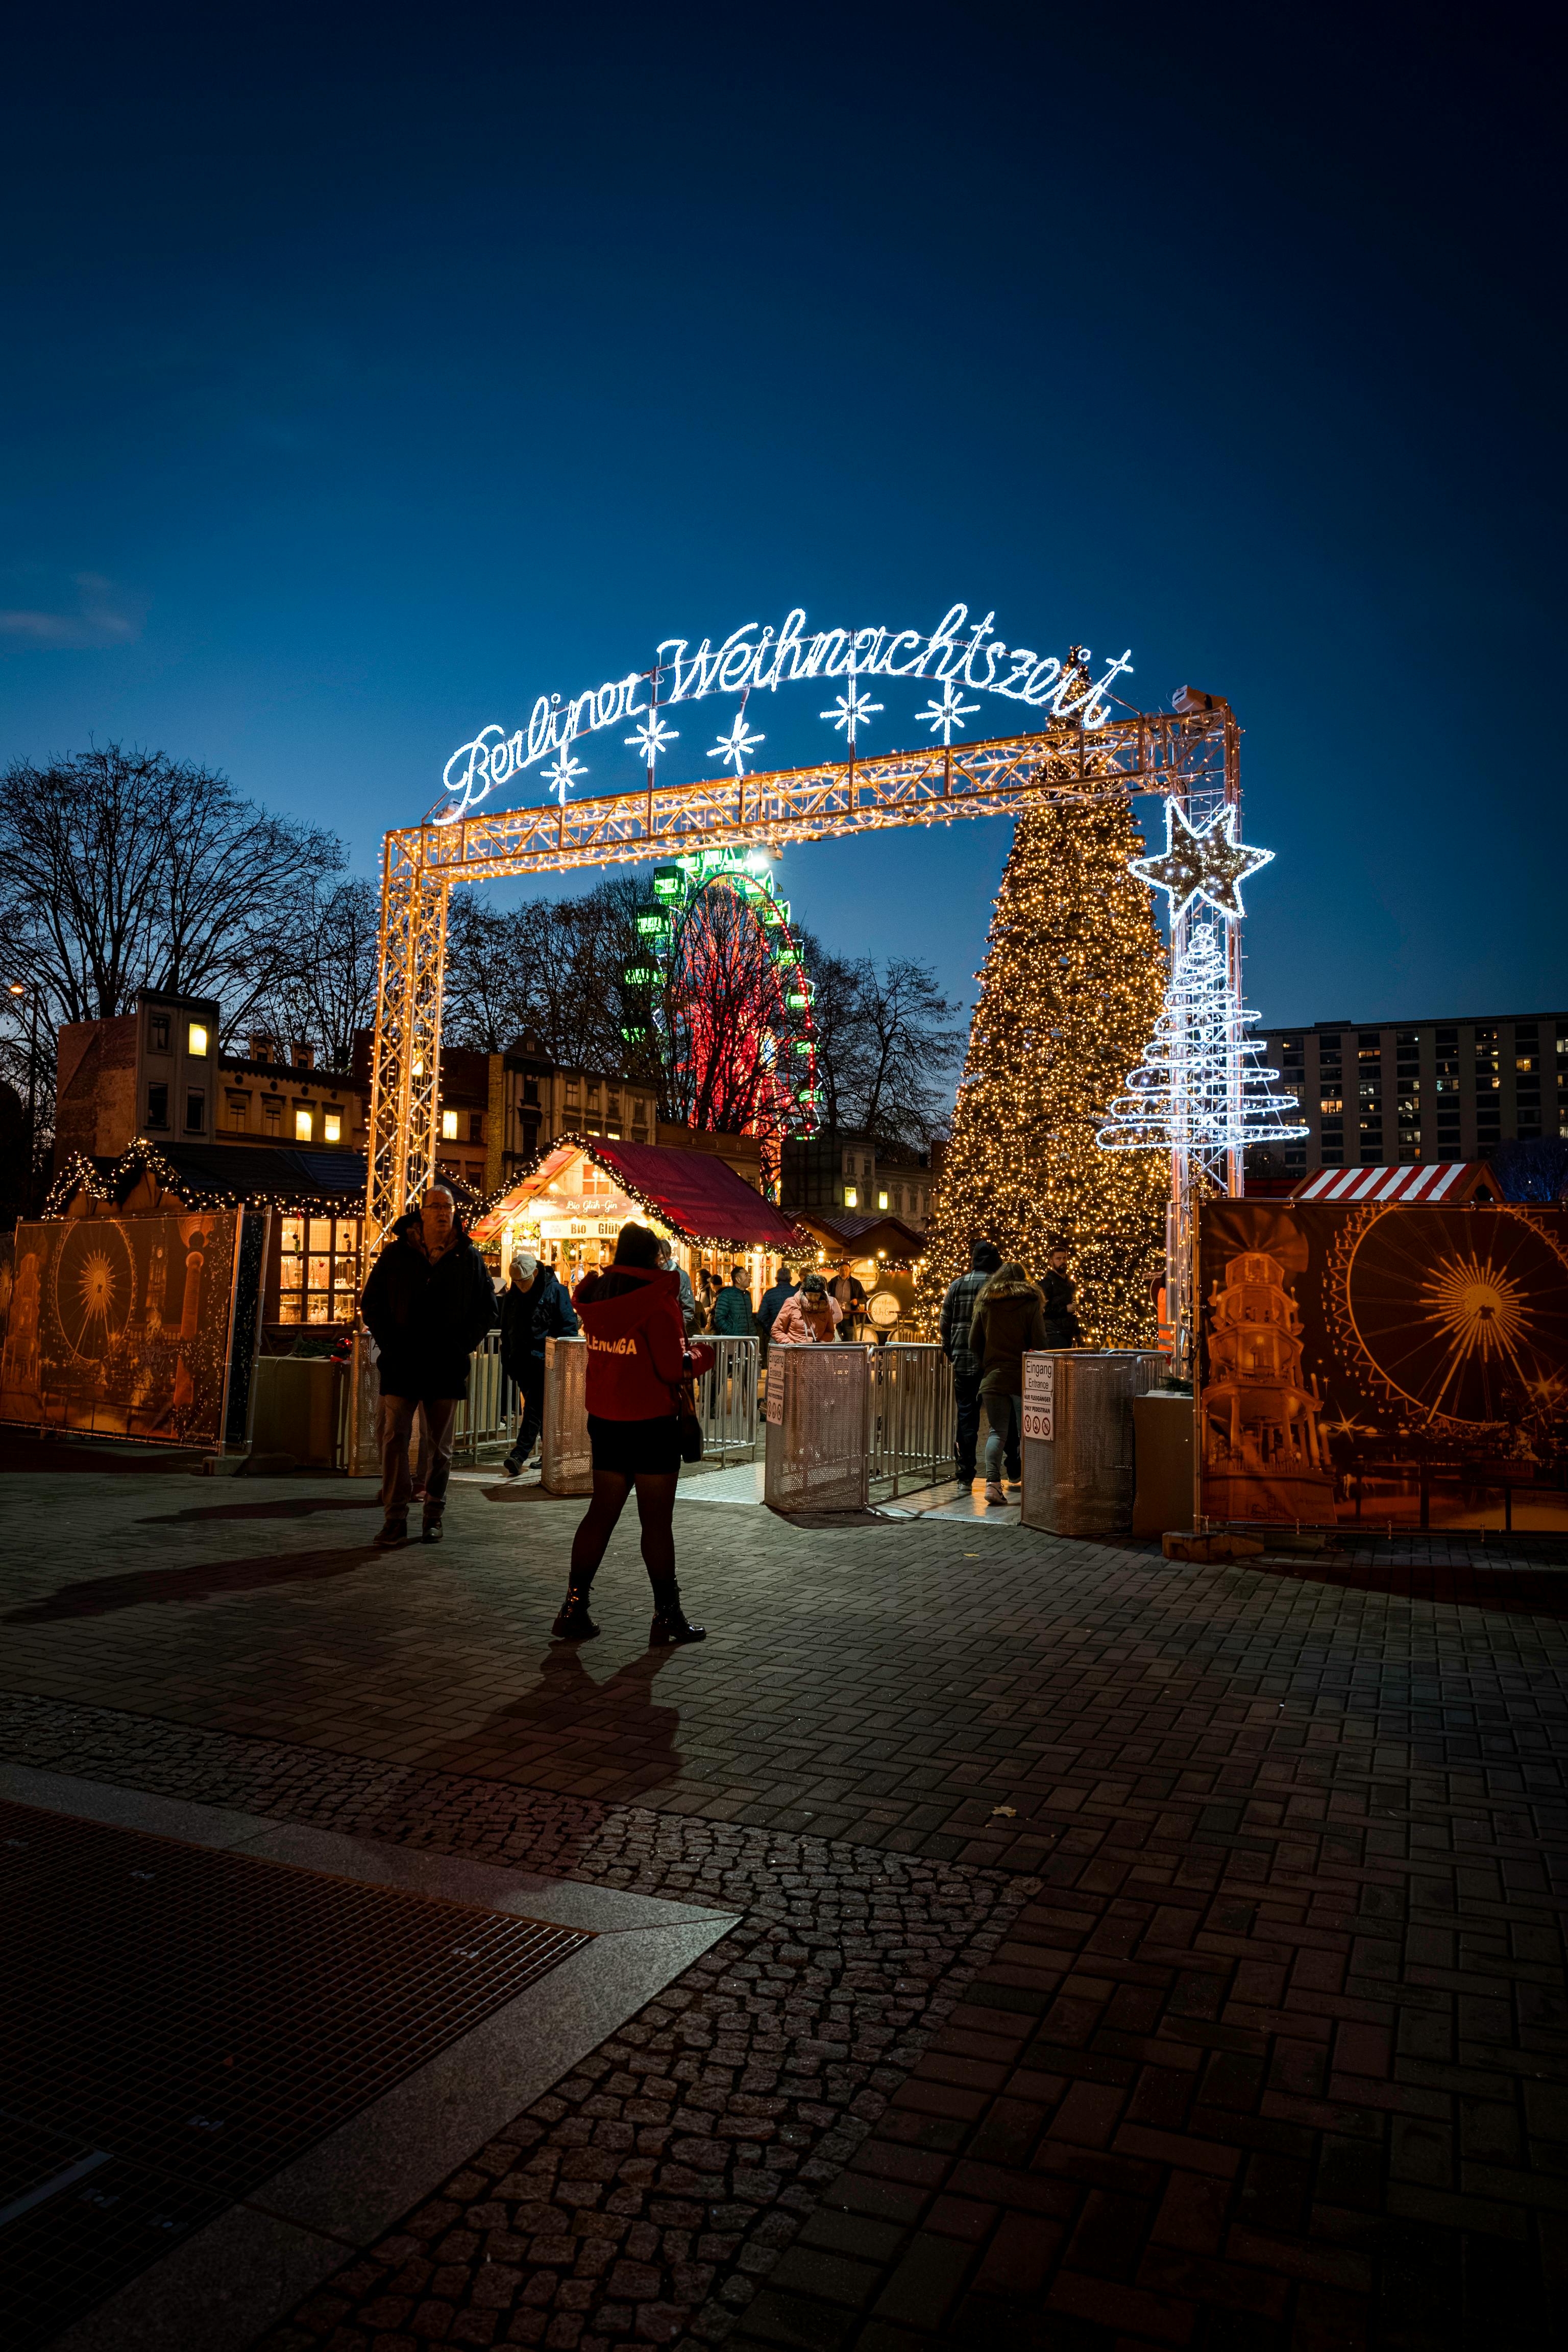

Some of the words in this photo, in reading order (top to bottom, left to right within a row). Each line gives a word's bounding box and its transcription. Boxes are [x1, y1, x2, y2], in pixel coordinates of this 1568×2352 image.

[432, 673, 647, 826] Berliner
[656, 602, 1133, 730] Weihnachtszeit
[566, 1200, 580, 1210] Bio
[582, 1199, 618, 1213] Glüh-Gin
[571, 1223, 586, 1234] Bio
[1026, 1360, 1052, 1379] Eingang
[1028, 1378, 1049, 1389] Entrance
